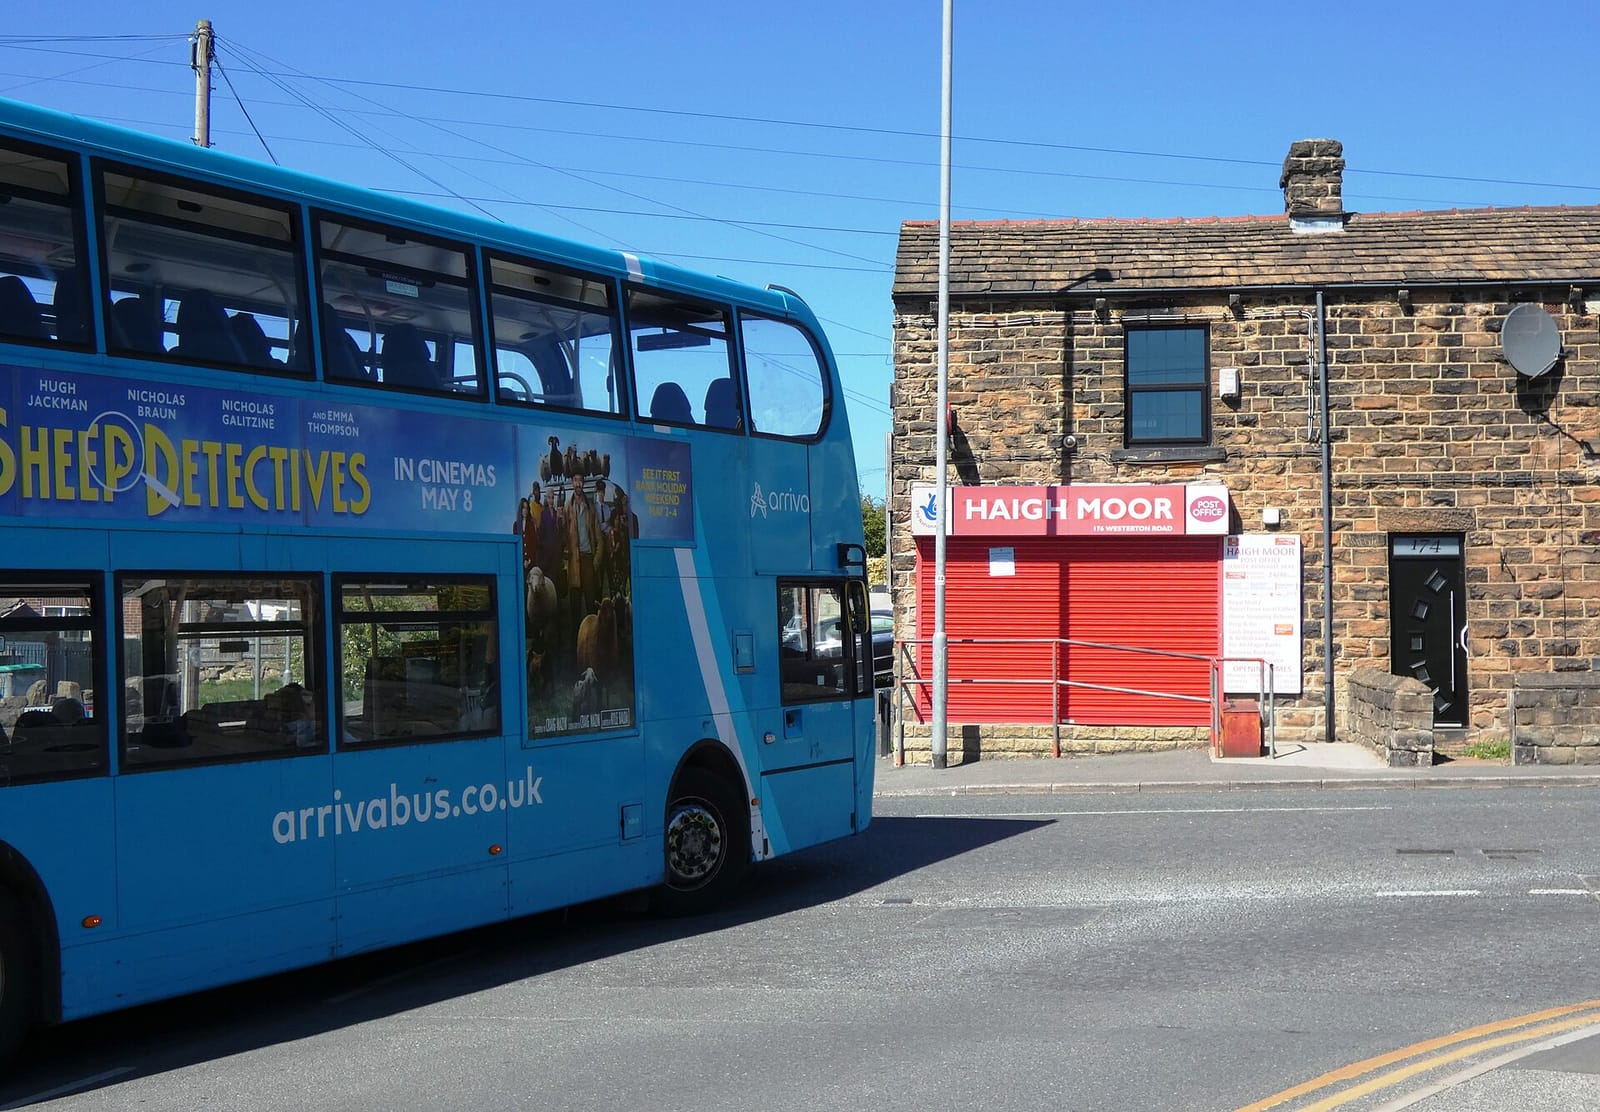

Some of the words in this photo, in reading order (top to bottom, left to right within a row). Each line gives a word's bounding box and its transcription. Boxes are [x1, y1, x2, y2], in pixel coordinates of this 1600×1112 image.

[39, 379, 77, 395] HUGH
[27, 394, 88, 411] JACKMAN
[128, 389, 186, 407] NICHOLAS
[137, 405, 177, 420] BRAUN
[221, 399, 275, 416] NICHOLAS
[221, 414, 275, 429] GALITZINE
[312, 411, 327, 420] AND
[327, 410, 354, 424] EMMA
[307, 422, 360, 437] THOMPSON
[394, 457, 414, 481] IN
[417, 459, 497, 488] CINEMAS
[662, 470, 681, 481] FIRST
[655, 481, 687, 494] HOLIDAY
[421, 487, 460, 511] MAY
[463, 490, 473, 512] 8
[768, 487, 811, 513] arriva
[1197, 500, 1220, 508] POST
[965, 497, 1068, 520] HAIGH
[1077, 497, 1174, 521] MOOR
[1192, 507, 1223, 517] OFFICE
[1227, 547, 1260, 556] HAIGH
[1262, 547, 1296, 556] MOOR
[1411, 538, 1442, 553] 174
[272, 766, 543, 844] arrivabus.co.uk
